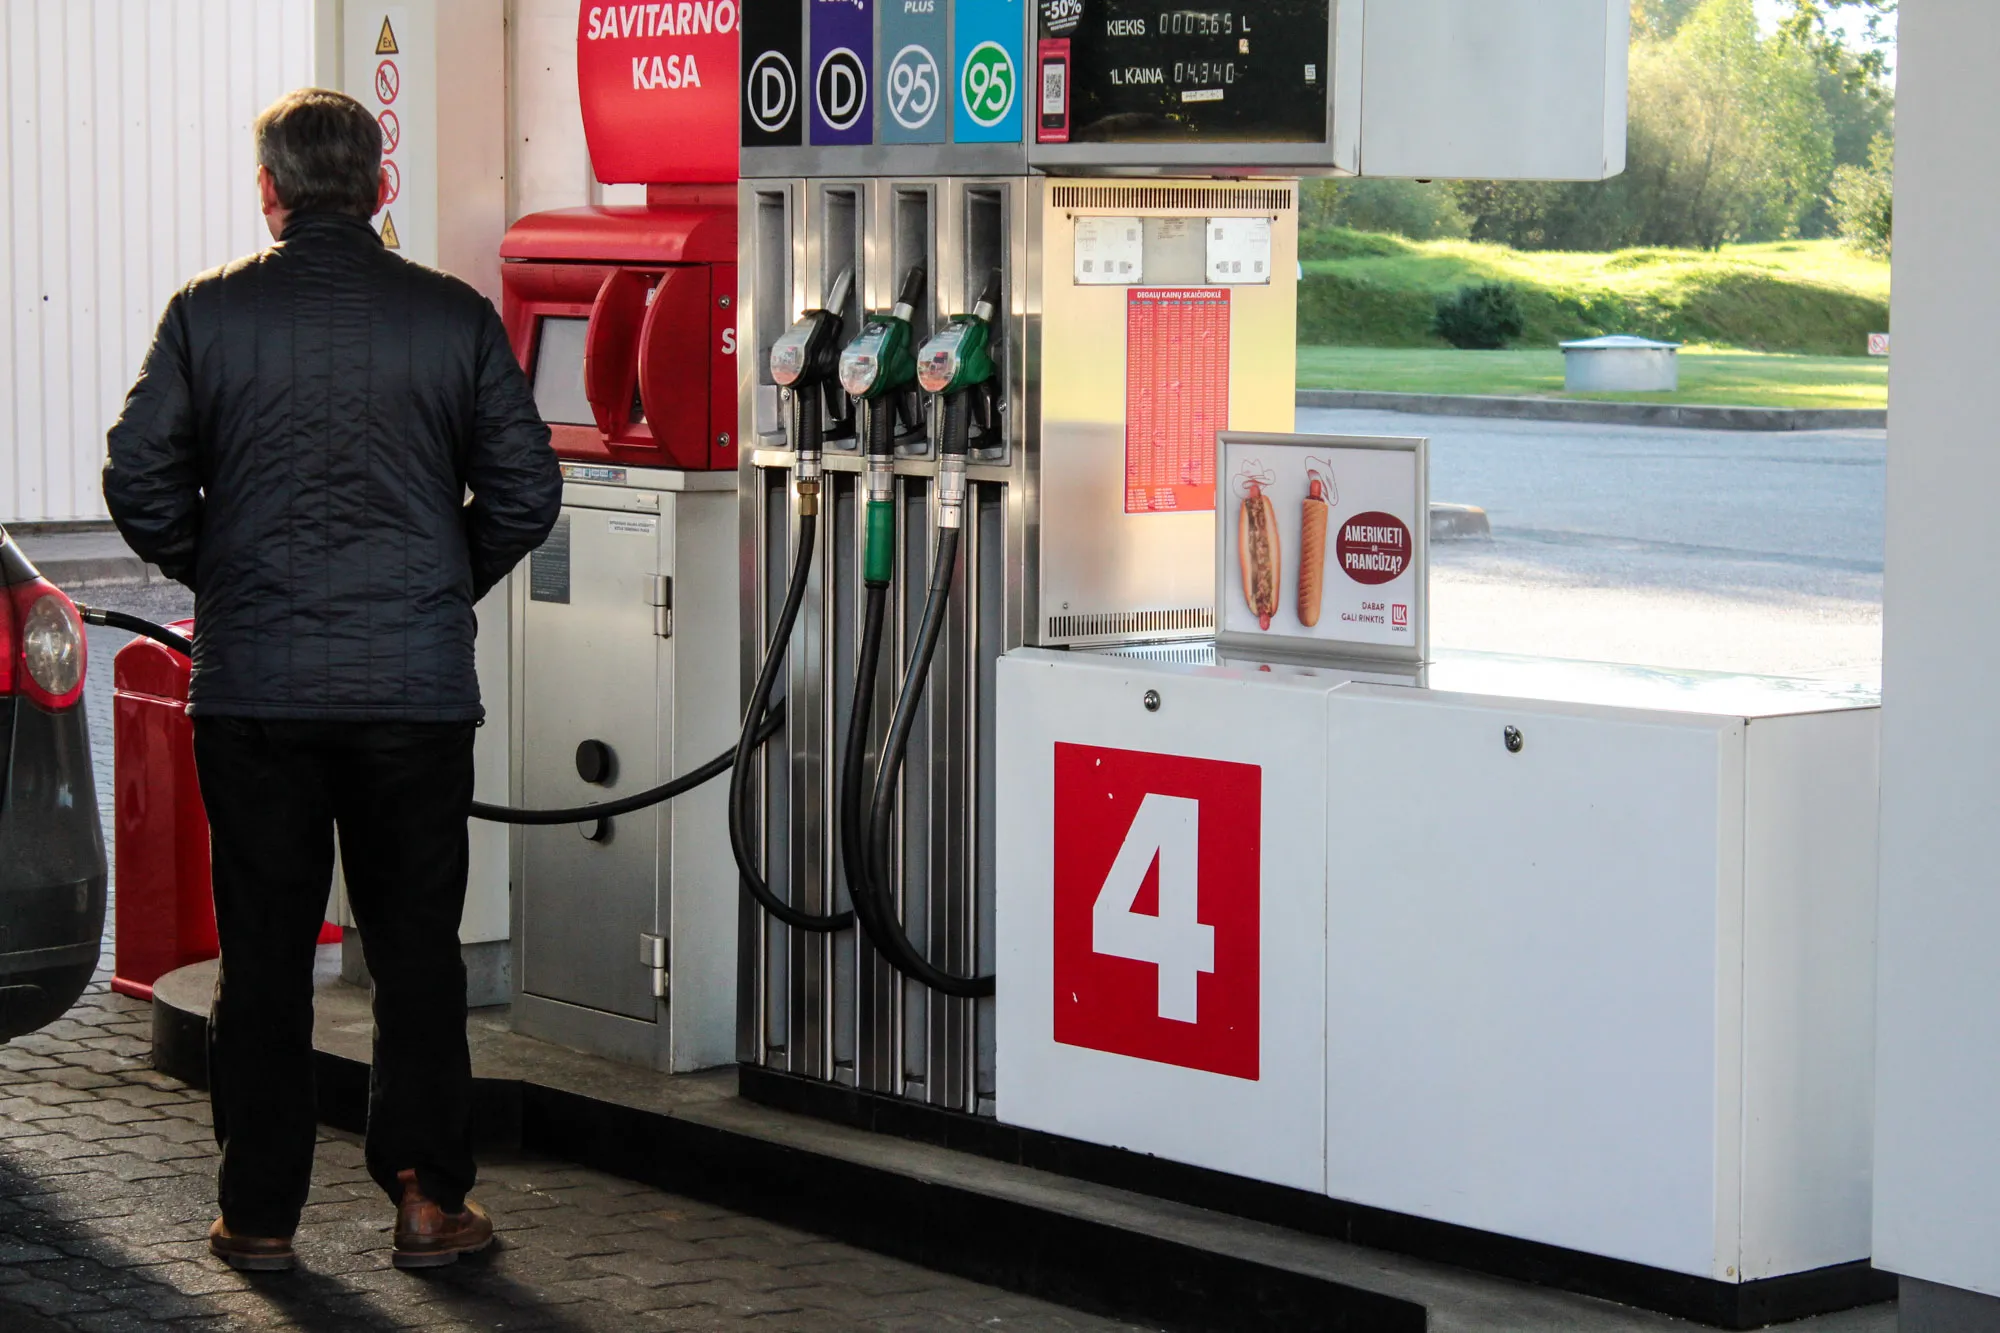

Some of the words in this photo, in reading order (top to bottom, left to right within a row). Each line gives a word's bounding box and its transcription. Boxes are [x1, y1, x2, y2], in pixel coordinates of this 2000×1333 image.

[903, 0, 935, 13] PLUS
[1045, 0, 1082, 19] -50%
[587, 0, 740, 41] SAVITARNO
[1106, 19, 1146, 36] KIEKIS
[1242, 15, 1251, 32] L
[383, 37, 392, 47] Ex
[631, 54, 702, 90] KASA
[1110, 68, 1123, 84] 1L
[1125, 67, 1165, 84] KAINA
[762, 67, 786, 118] D
[831, 64, 857, 116] D
[893, 63, 932, 114] 95
[969, 62, 1008, 112] 95
[1136, 291, 1161, 300] DEGALŲ
[1162, 291, 1181, 300] KAINŲ
[1345, 525, 1403, 547] AMERIKIETĮ
[1345, 552, 1403, 575] PRANCŪZĄ?
[1362, 602, 1385, 611] DABAR
[1341, 612, 1357, 622] GALI
[1358, 614, 1385, 624] RINKTIS
[1092, 793, 1214, 1024] 4
